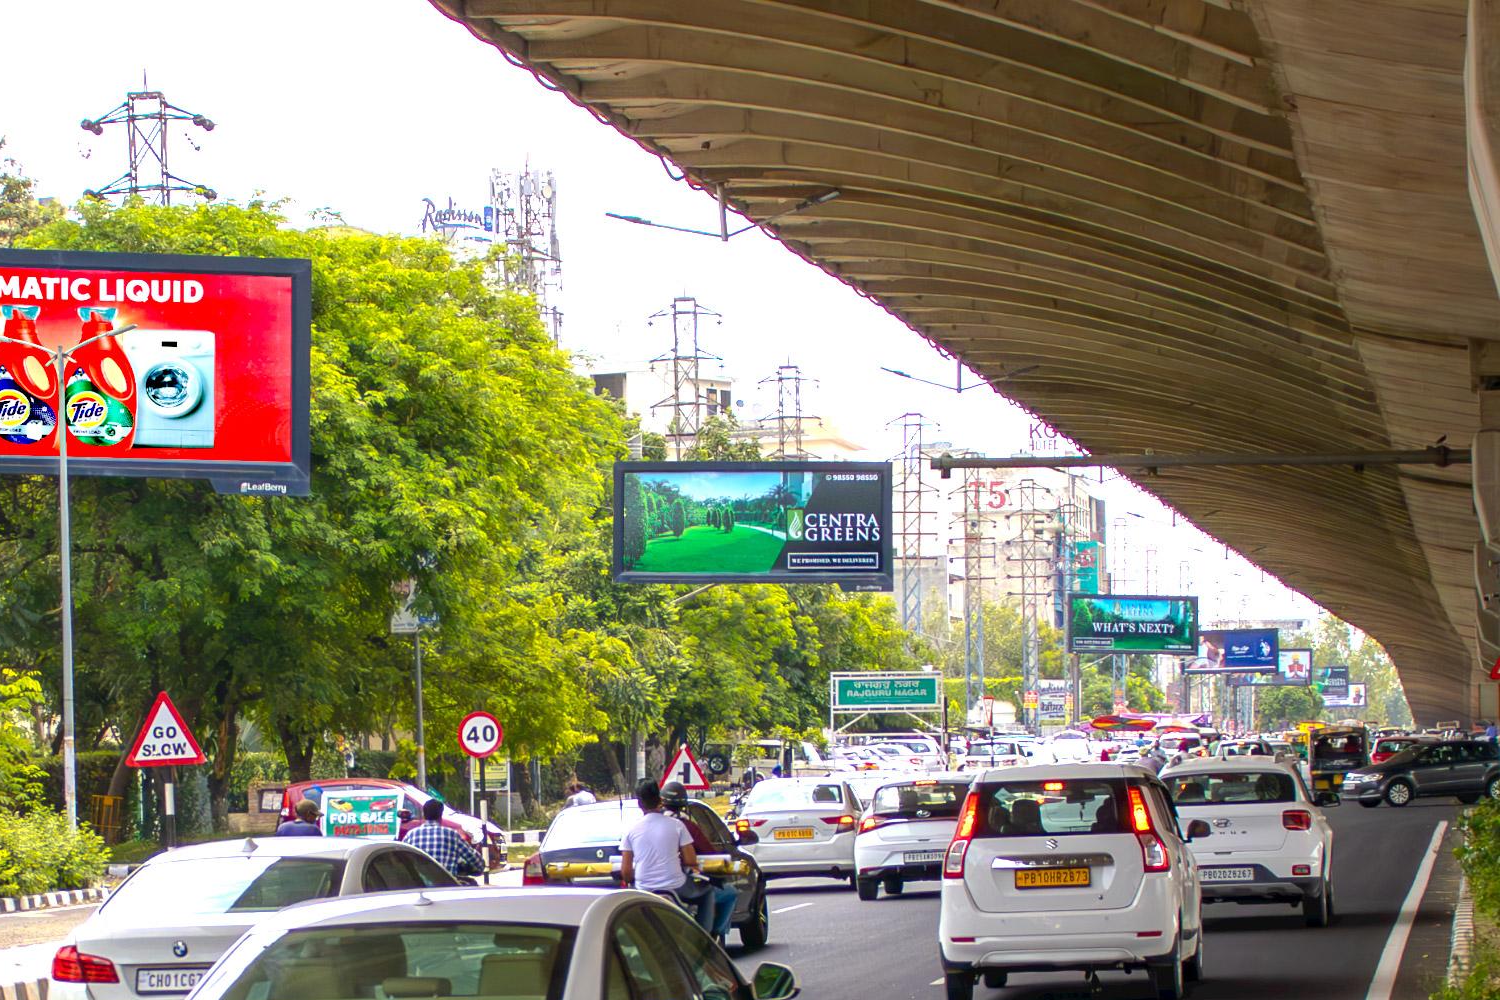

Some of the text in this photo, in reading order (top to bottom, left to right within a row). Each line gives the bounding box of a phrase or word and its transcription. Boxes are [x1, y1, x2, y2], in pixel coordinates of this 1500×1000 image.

[421, 196, 485, 233] Radisson
[99, 278, 204, 303] LIQUID
[71, 402, 104, 423] Tide
[247, 482, 287, 494] LeafBerry
[804, 513, 879, 527] CENTRA
[804, 527, 880, 541] GREENS
[1092, 622, 1175, 634] WHAT'S NEXT?
[846, 688, 927, 697] RAJGURU NAGAR
[153, 726, 177, 739] GO
[466, 724, 495, 744] 40
[142, 742, 187, 757] SLOW
[329, 811, 394, 824] FOR SALE
[148, 973, 203, 987] CH01CG7
